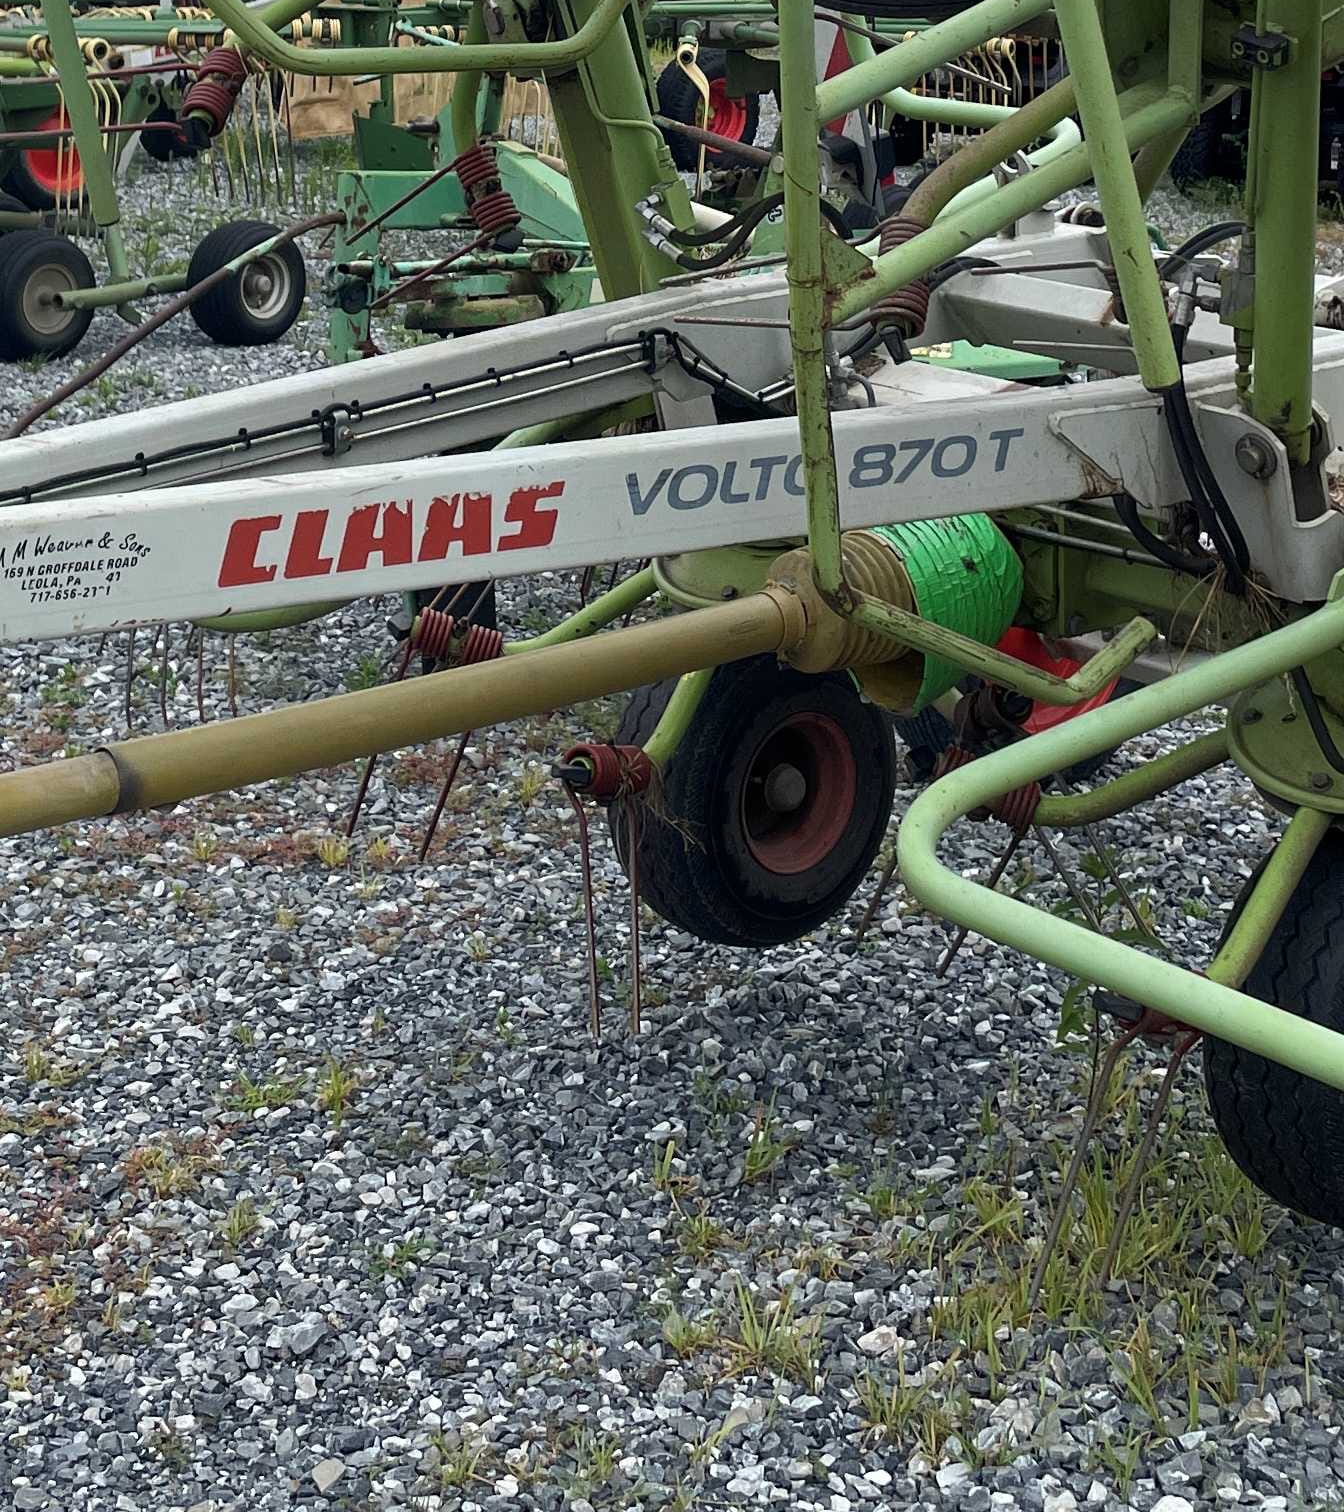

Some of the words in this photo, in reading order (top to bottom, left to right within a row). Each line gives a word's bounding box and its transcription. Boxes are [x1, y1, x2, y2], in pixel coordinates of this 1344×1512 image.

[849, 435, 978, 488] 870
[989, 428, 1024, 472] T
[12, 539, 28, 565] M
[98, 531, 114, 549] &
[218, 481, 566, 587] CLAAS
[26, 566, 35, 577] N
[38, 559, 104, 576] GROFFDALE
[107, 557, 138, 569] ROAD
